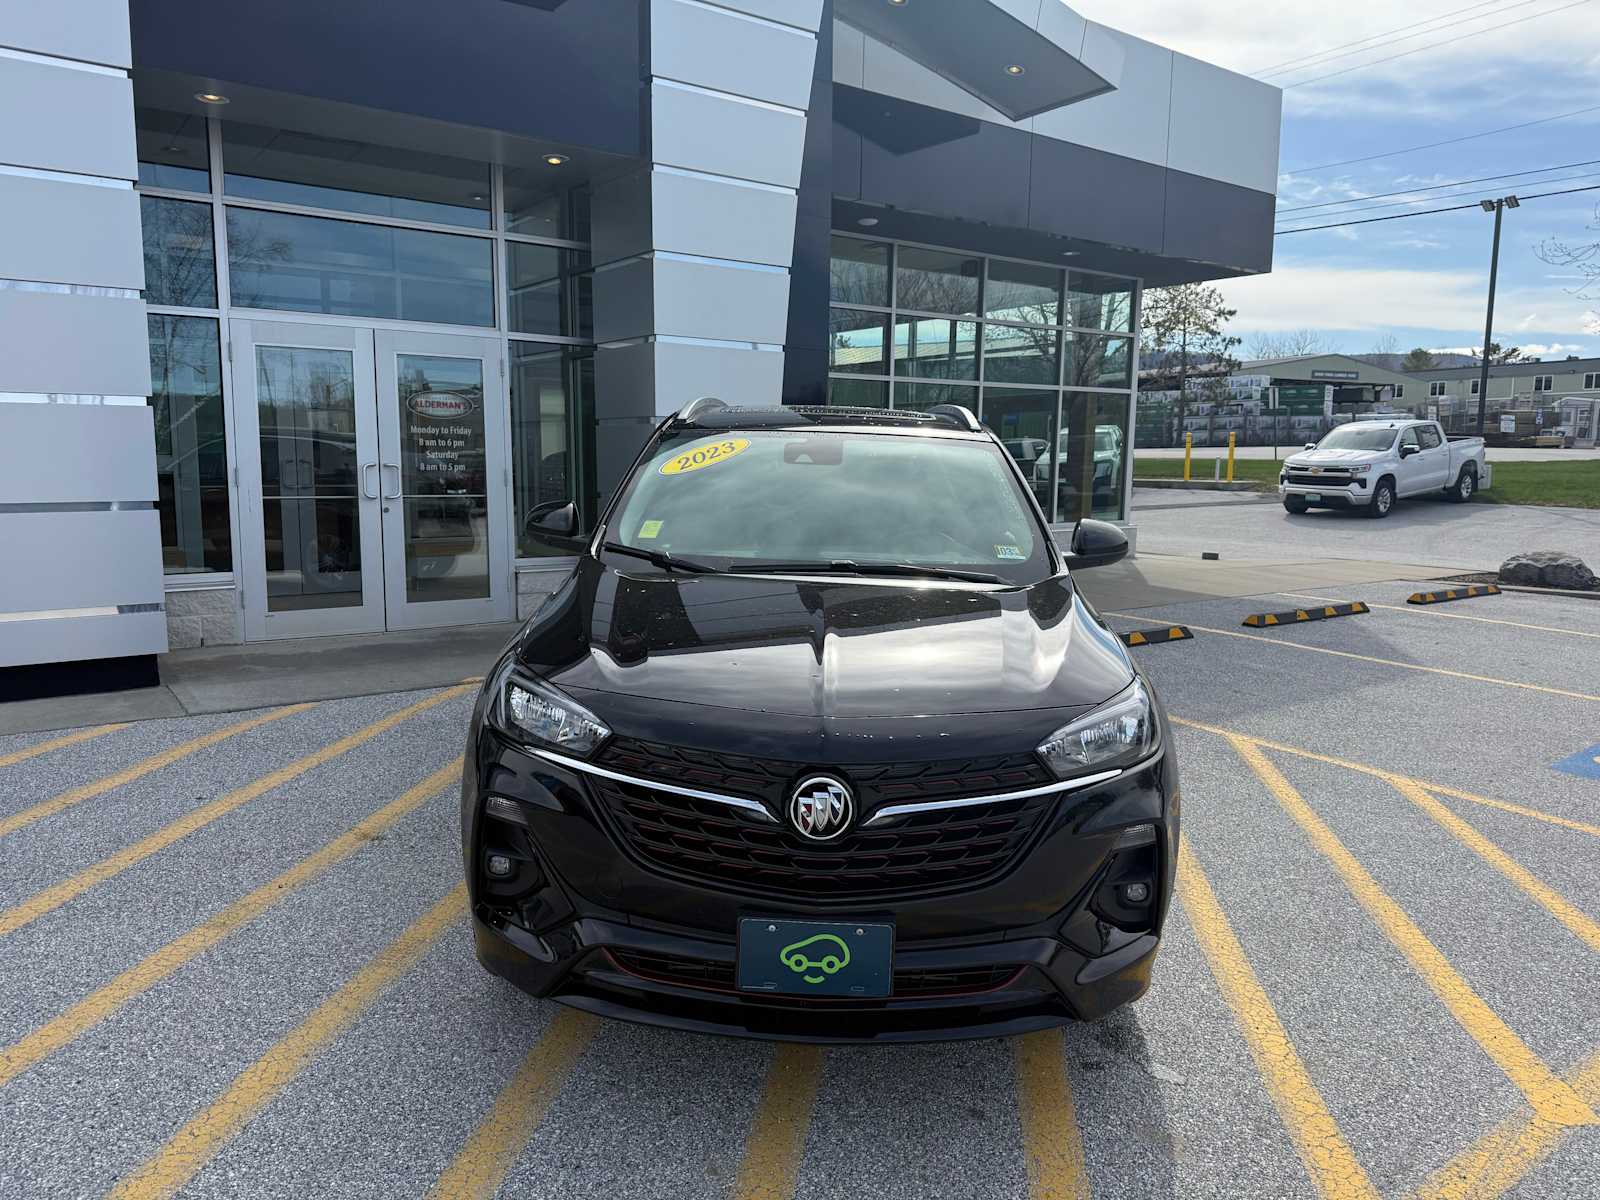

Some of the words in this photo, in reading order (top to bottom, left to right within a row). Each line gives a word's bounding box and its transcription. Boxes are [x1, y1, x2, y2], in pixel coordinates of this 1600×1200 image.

[410, 425, 440, 436] Monday
[450, 426, 472, 437] Friday
[419, 438, 424, 446] 8
[439, 439, 446, 447] to
[453, 440, 465, 449] pm
[426, 450, 459, 460] Saturday
[677, 442, 736, 470] 2023
[439, 463, 446, 471] to
[448, 463, 453, 471] 5
[454, 464, 466, 473] pm
